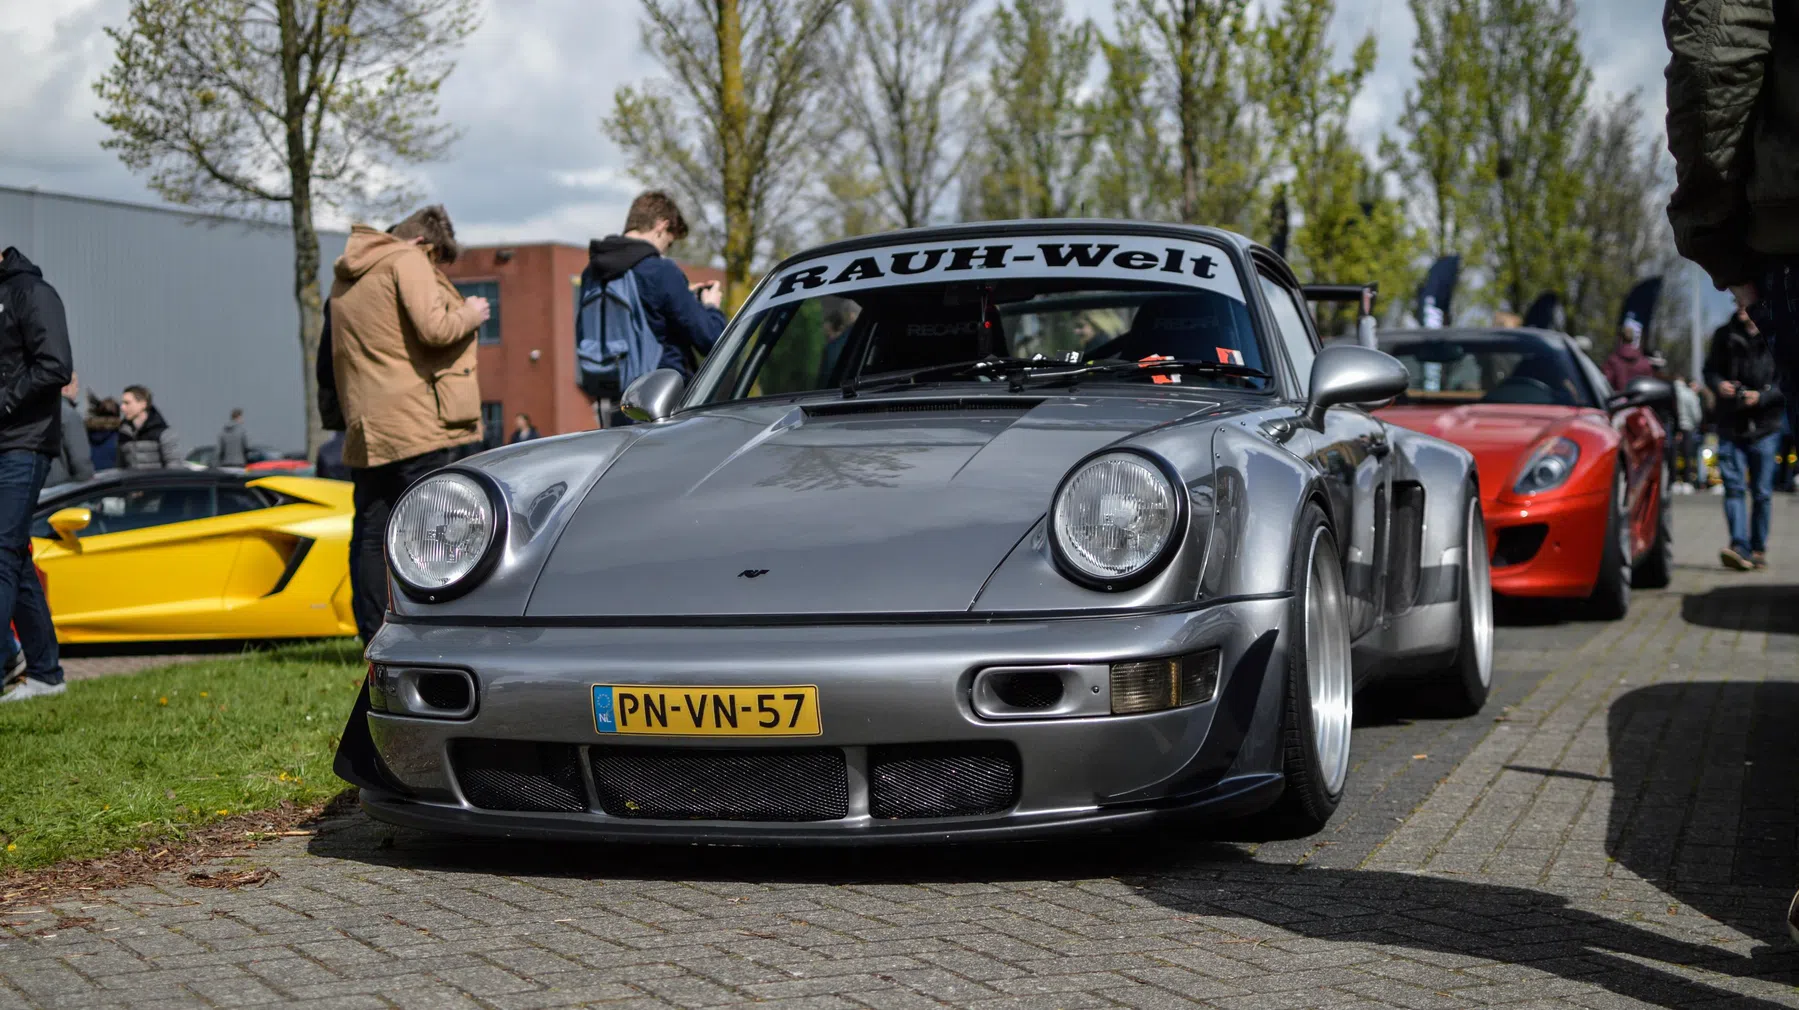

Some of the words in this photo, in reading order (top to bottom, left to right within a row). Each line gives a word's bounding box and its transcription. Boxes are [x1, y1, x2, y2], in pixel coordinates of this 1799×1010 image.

[770, 243, 1218, 298] RAUH-Welt
[599, 713, 612, 722] NL
[618, 693, 806, 728] PN-VN-57
